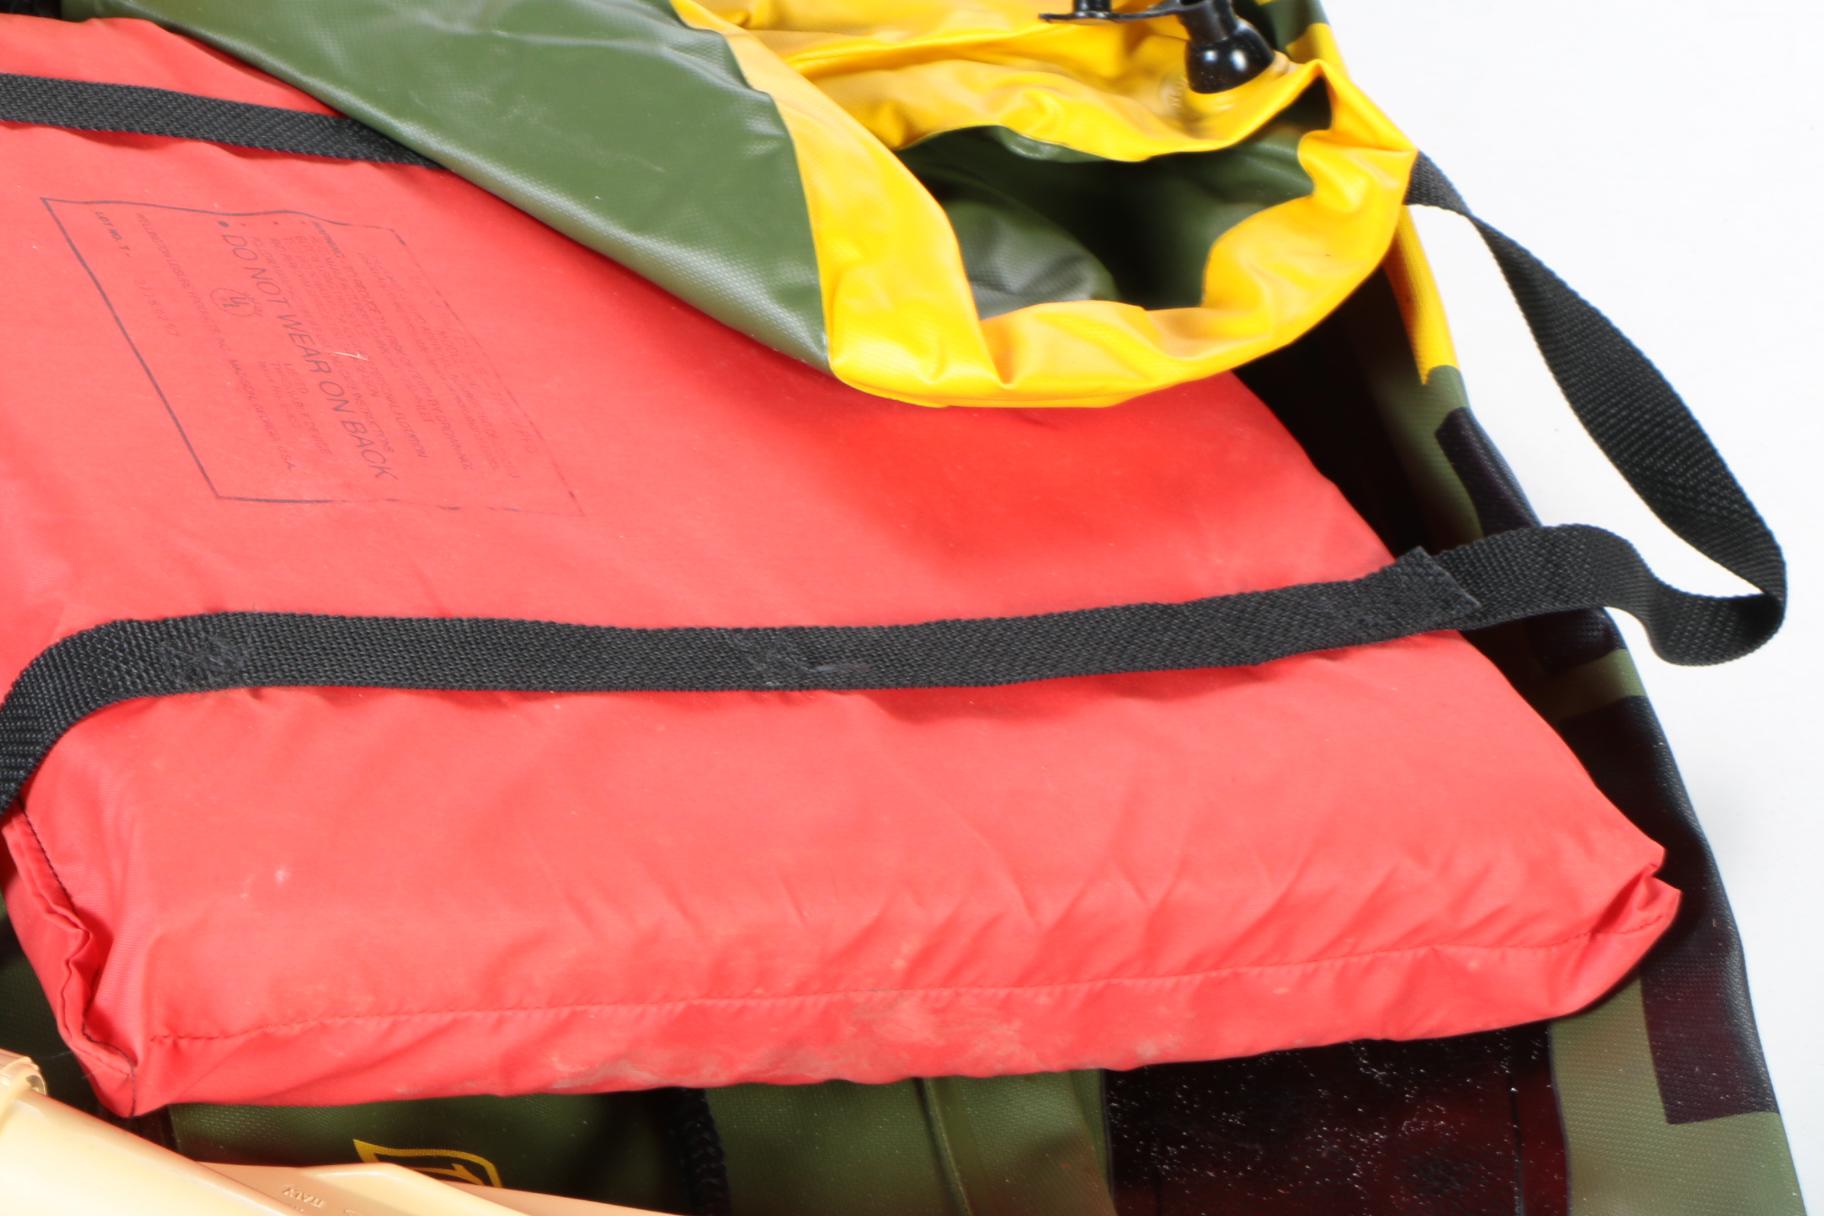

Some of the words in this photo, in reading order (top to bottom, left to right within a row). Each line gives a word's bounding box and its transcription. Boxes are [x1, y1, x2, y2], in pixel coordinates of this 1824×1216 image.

[221, 233, 259, 261] DO
[243, 265, 291, 308] NOT
[277, 313, 332, 375] WEAR
[319, 381, 354, 414] ON
[341, 420, 400, 481] BACK
